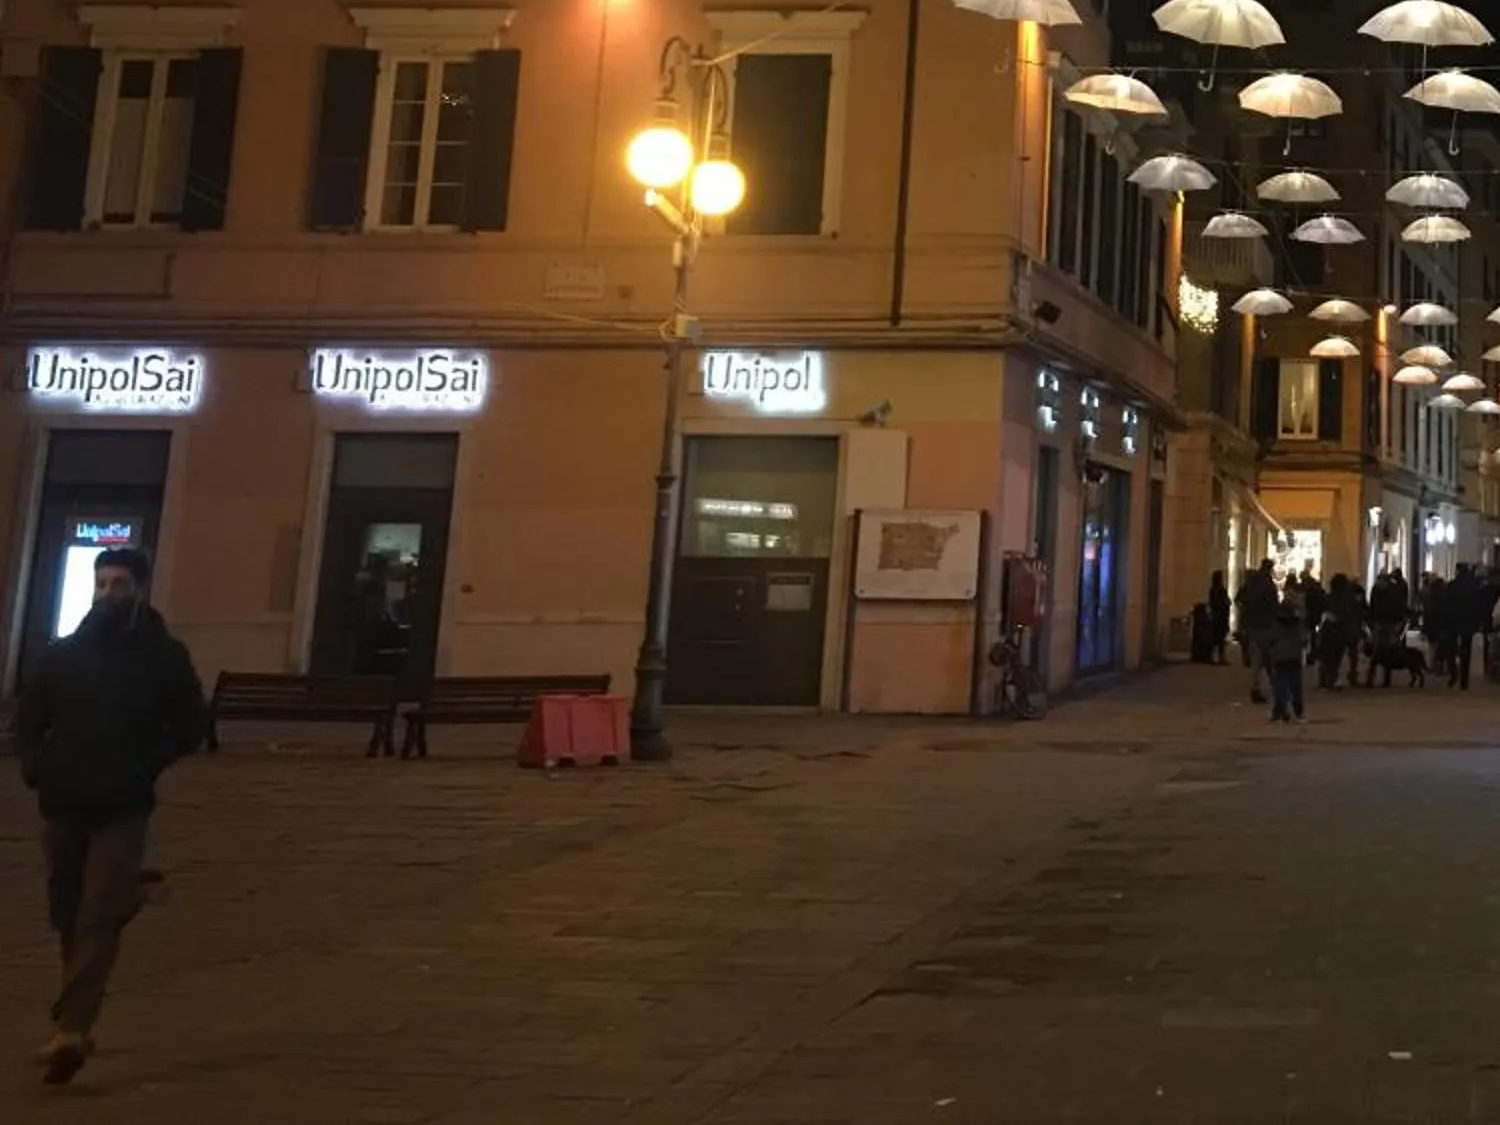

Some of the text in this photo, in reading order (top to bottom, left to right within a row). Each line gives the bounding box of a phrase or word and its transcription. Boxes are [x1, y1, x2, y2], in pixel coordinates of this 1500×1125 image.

[30, 353, 196, 403] UnipolSai
[315, 353, 480, 403] UnipolSai
[706, 354, 811, 403] Unipol
